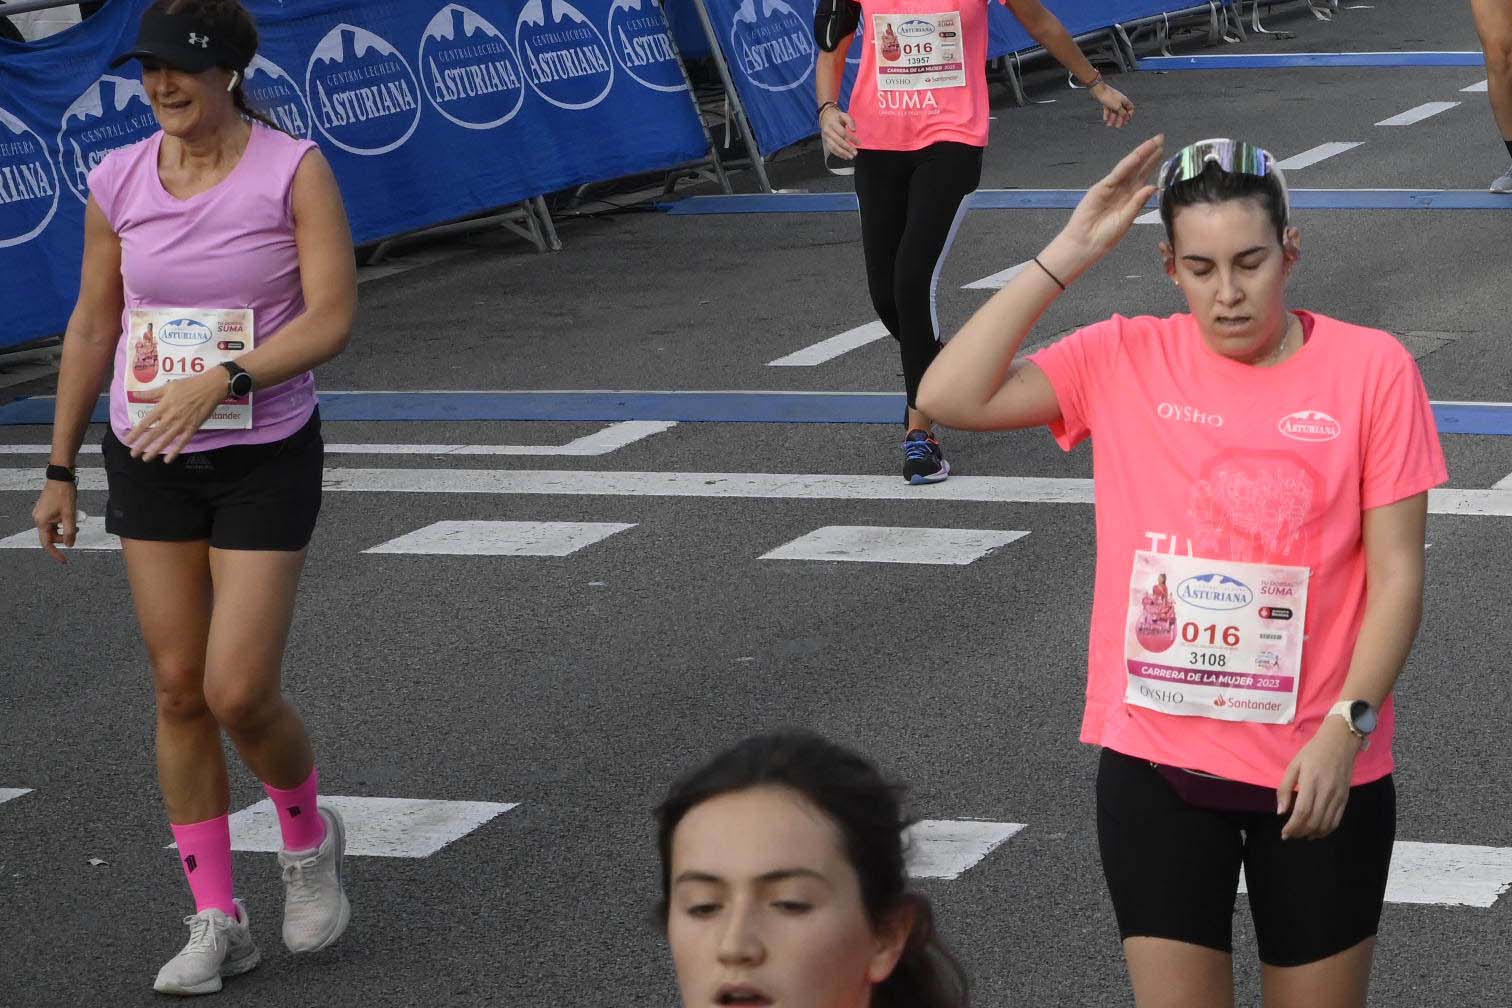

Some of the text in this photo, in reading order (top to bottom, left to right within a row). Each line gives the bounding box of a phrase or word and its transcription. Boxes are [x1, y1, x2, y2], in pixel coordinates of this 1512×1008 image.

[903, 42, 933, 55] 016
[526, 39, 610, 84] ASTURIANA
[428, 55, 521, 104] ASTURIANA
[318, 79, 417, 130] ASTURIANA
[877, 91, 938, 109] SUMA
[162, 328, 208, 340] ASTURIANA
[217, 325, 243, 333] SUMA
[162, 356, 204, 373] 016
[1157, 402, 1223, 427] OYSHO
[1182, 584, 1248, 604] ASTURIANA
[1261, 586, 1293, 596] SUMA
[1182, 621, 1240, 646] 016
[1189, 651, 1226, 667] 3108
[1141, 666, 1280, 688] CARRERA DE LA MUJER 2023
[1228, 697, 1282, 711] Santander
